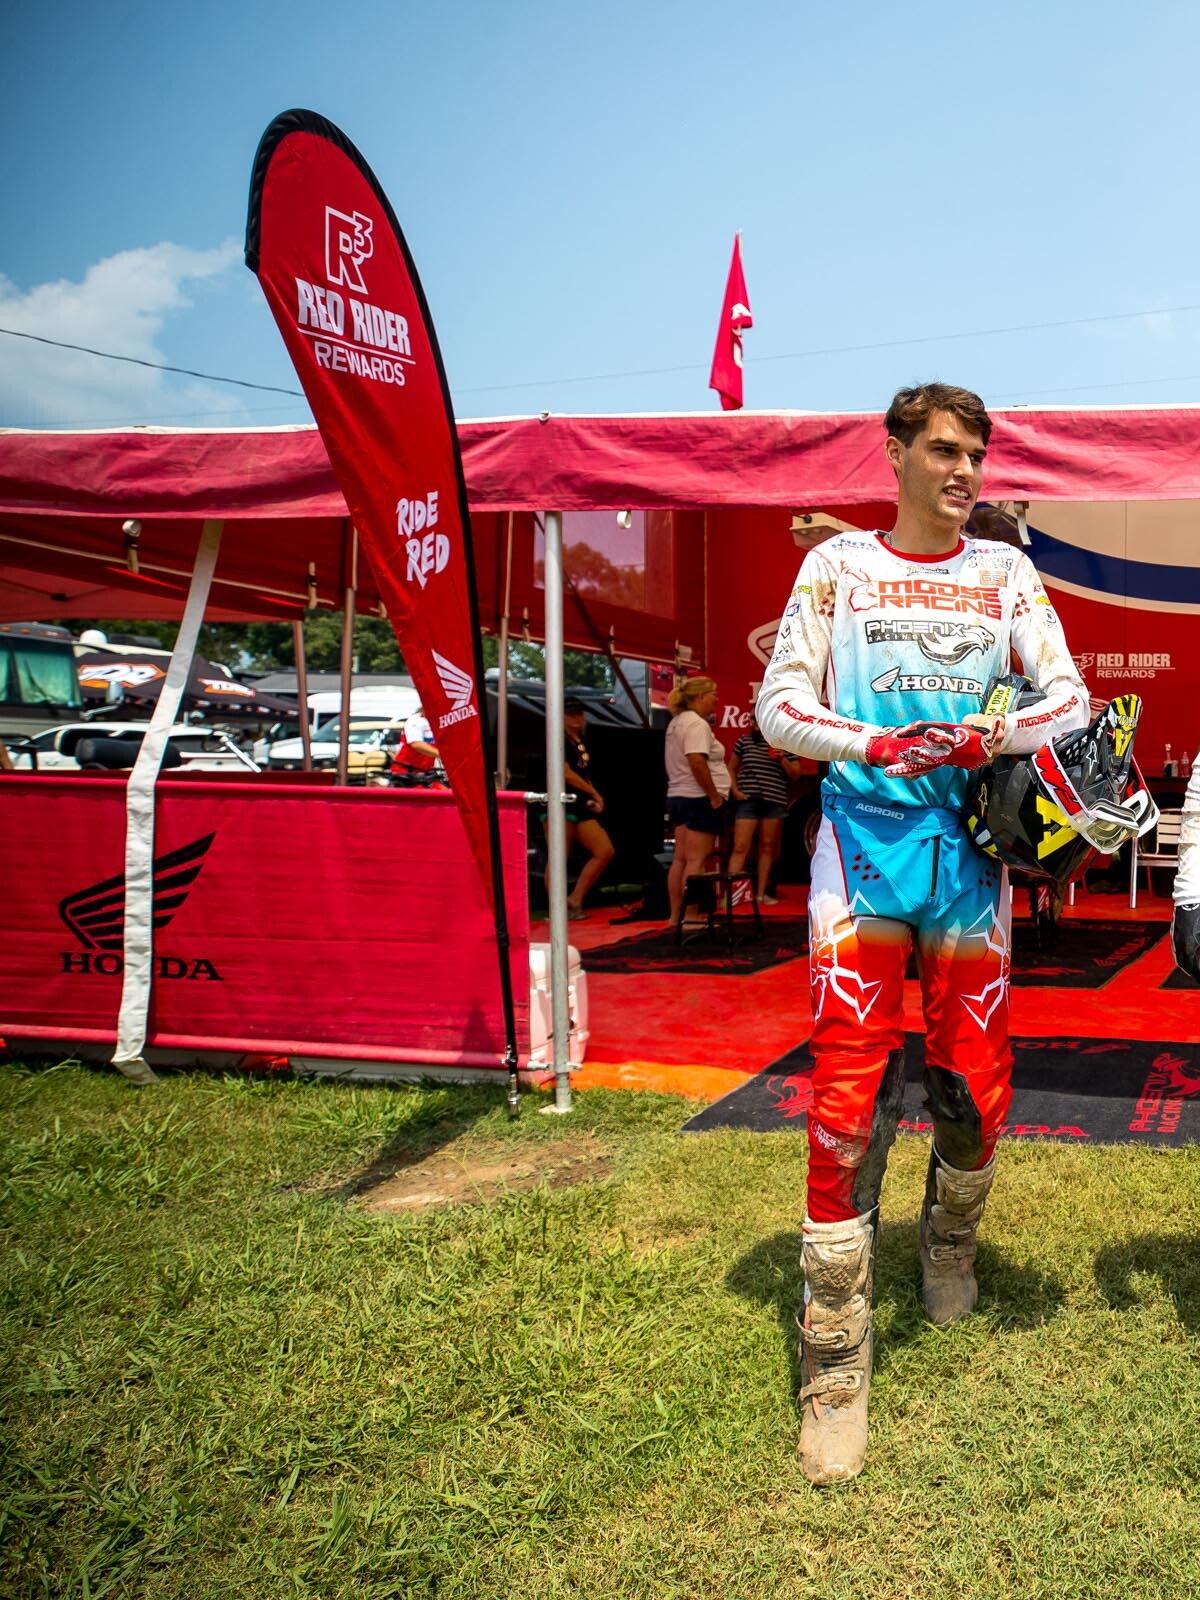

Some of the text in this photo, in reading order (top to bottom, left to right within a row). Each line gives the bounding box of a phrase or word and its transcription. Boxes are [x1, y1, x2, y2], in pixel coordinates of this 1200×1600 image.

[295, 277, 412, 356] RED RIDER
[314, 341, 406, 386] REWARDS
[395, 490, 439, 538] RIDE
[405, 531, 450, 590] RED
[878, 580, 1001, 604] MOOSE
[878, 595, 1003, 620] RACING
[865, 620, 967, 637] PHOENIX
[867, 634, 919, 643] RACING
[1096, 653, 1124, 667] RED
[1128, 653, 1171, 667] RIDER
[1096, 669, 1156, 679] REWARDS
[438, 704, 478, 729] HONDA
[720, 705, 752, 728] Re
[1017, 695, 1079, 729] MOOSE RACING
[816, 718, 865, 733] RACING
[855, 803, 905, 820] AGROID
[60, 951, 224, 981] HODA
[1157, 1096, 1184, 1133] RACING
